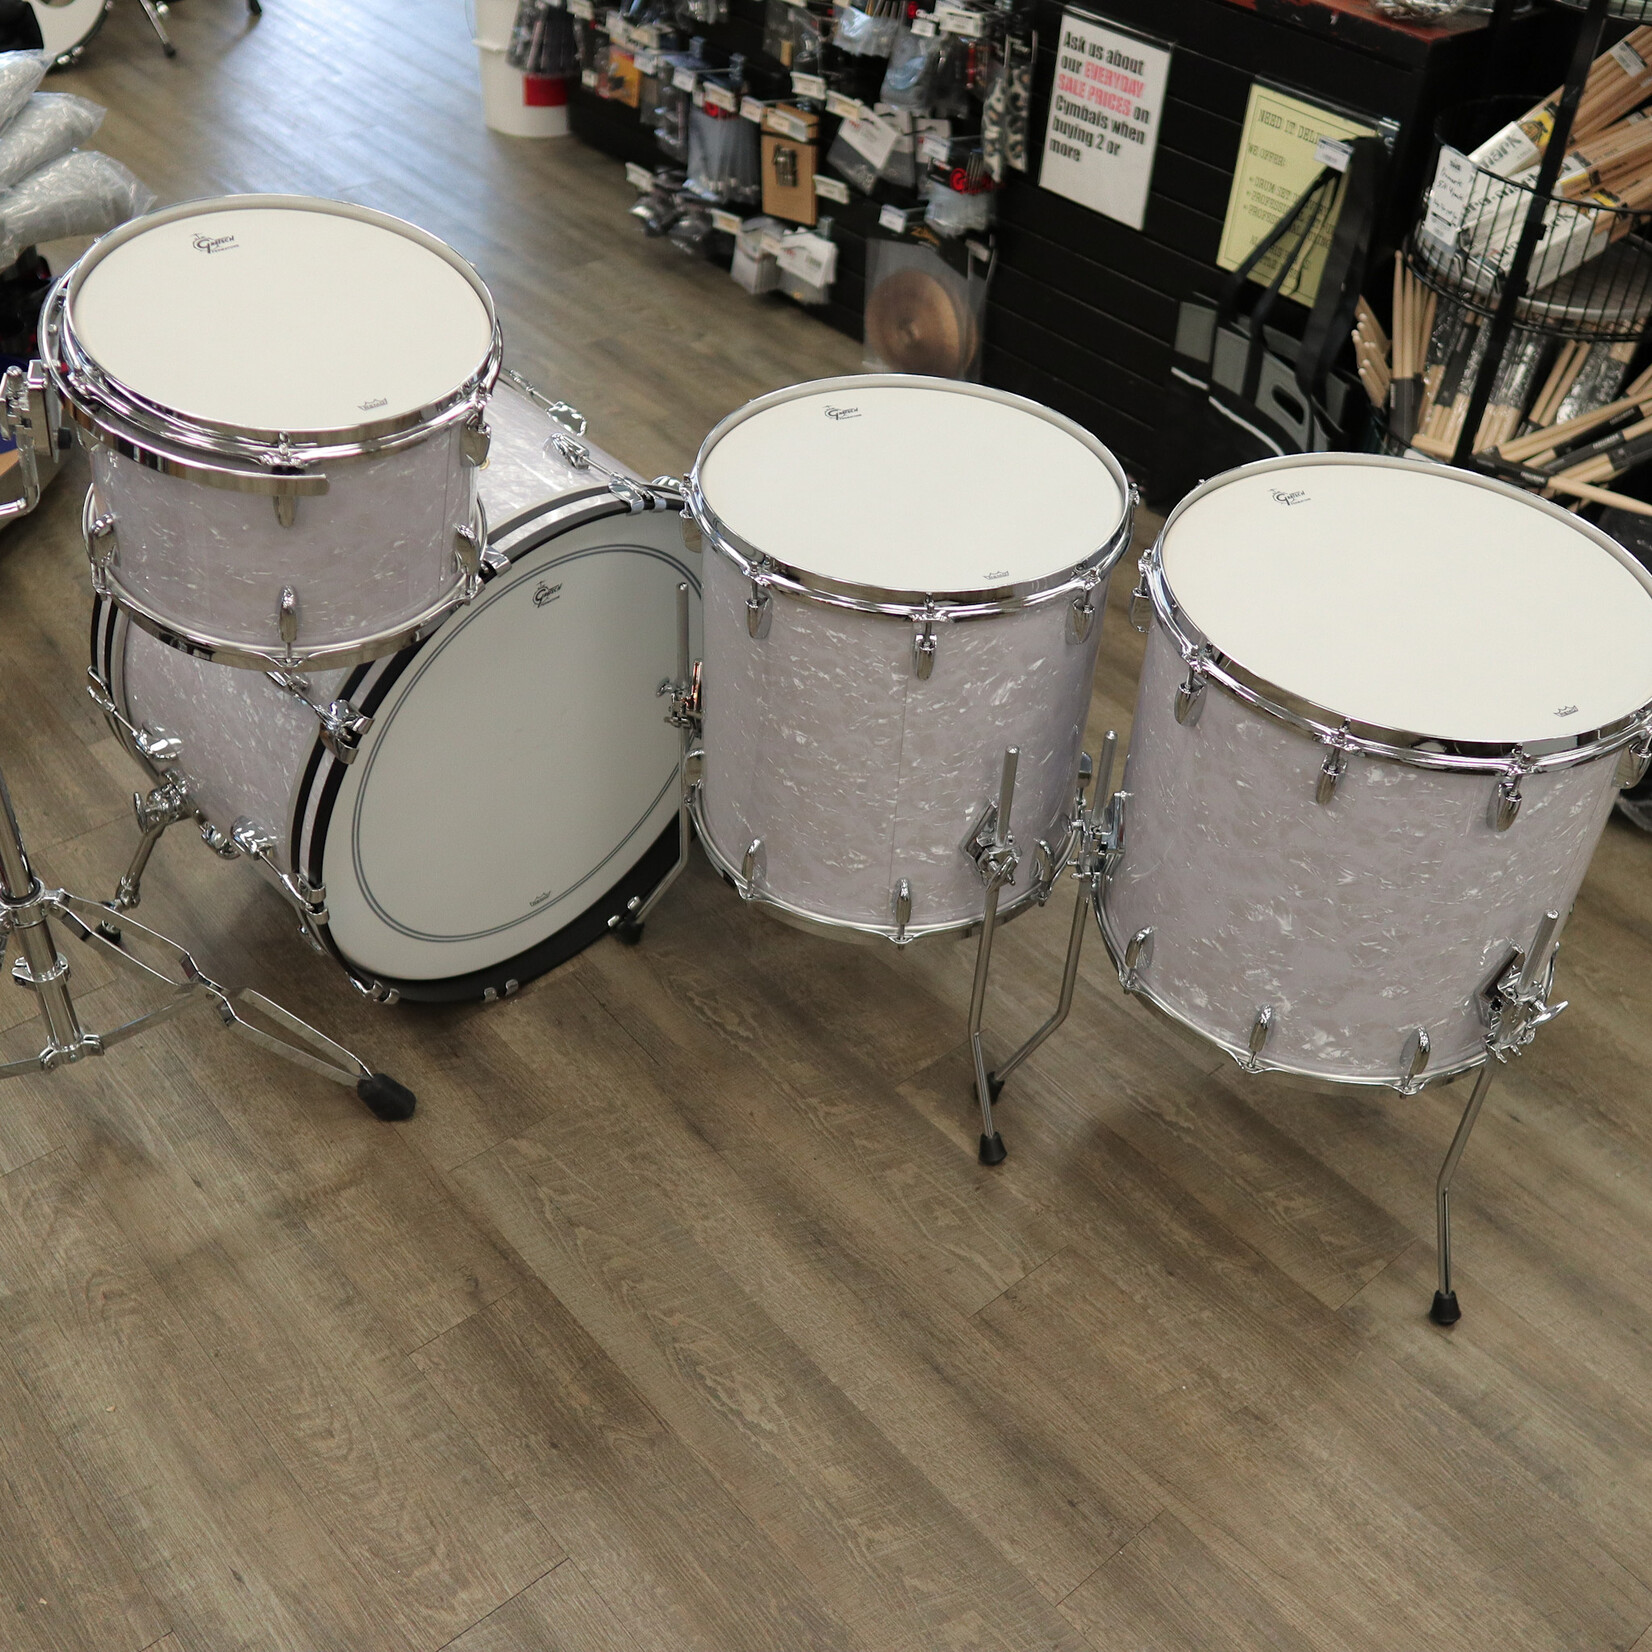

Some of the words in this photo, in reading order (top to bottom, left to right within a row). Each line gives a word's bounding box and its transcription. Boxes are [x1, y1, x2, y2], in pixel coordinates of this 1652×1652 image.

[1063, 31, 1085, 54] Ask
[1088, 42, 1104, 60] us
[1106, 49, 1144, 76] about
[1061, 55, 1082, 74] our
[1084, 61, 1144, 98] EVERYDAY
[1055, 95, 1108, 130] Cymbals
[1111, 118, 1145, 145] when
[1058, 73, 1085, 99] SALE
[1087, 85, 1131, 117] PRICES
[1134, 106, 1150, 124] on
[1052, 115, 1094, 148] buying
[1095, 134, 1104, 150] 2
[1106, 140, 1121, 156] or
[1259, 109, 1282, 129] NEED
[1285, 120, 1296, 134] IT
[1050, 138, 1081, 162] more
